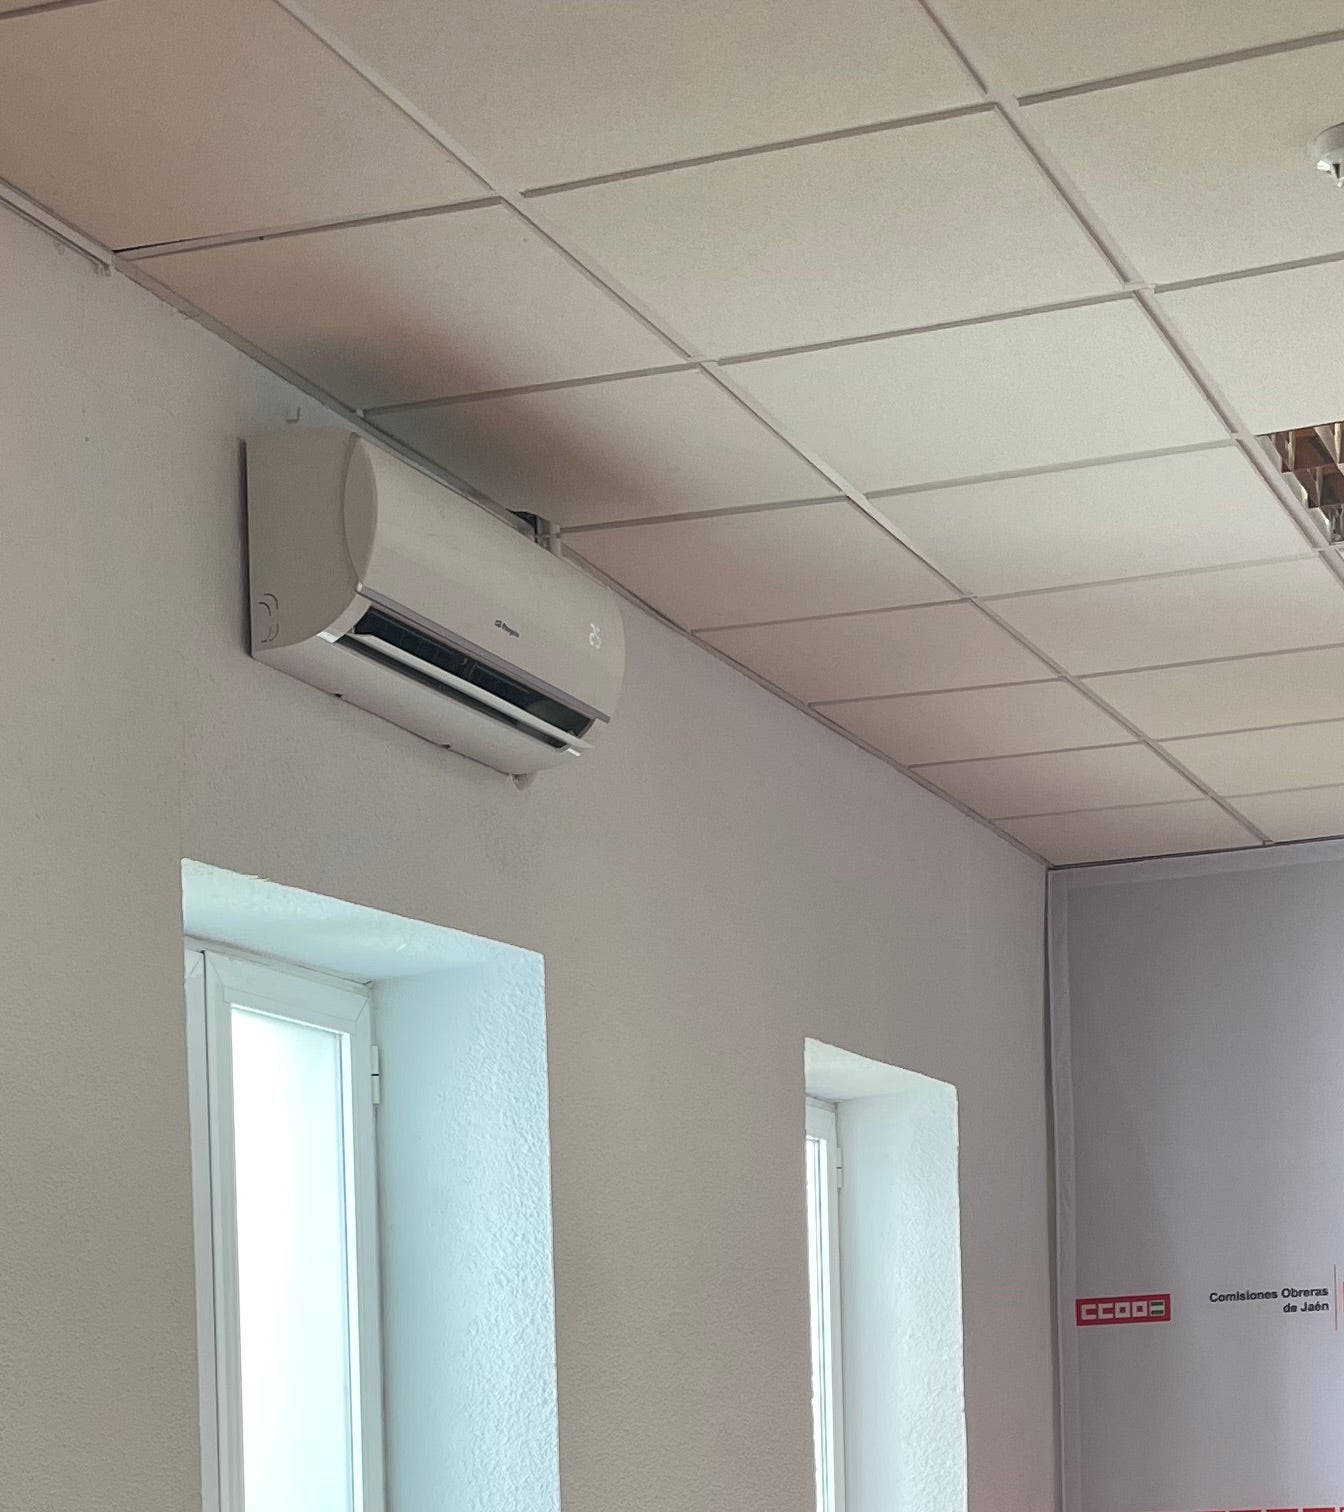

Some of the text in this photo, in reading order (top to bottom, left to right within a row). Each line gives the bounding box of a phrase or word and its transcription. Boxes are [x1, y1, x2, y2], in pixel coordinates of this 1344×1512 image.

[1209, 1287, 1329, 1303] Comisiones Obreras
[1081, 1301, 1149, 1321] CCOO
[1283, 1301, 1329, 1313] de Jaén
